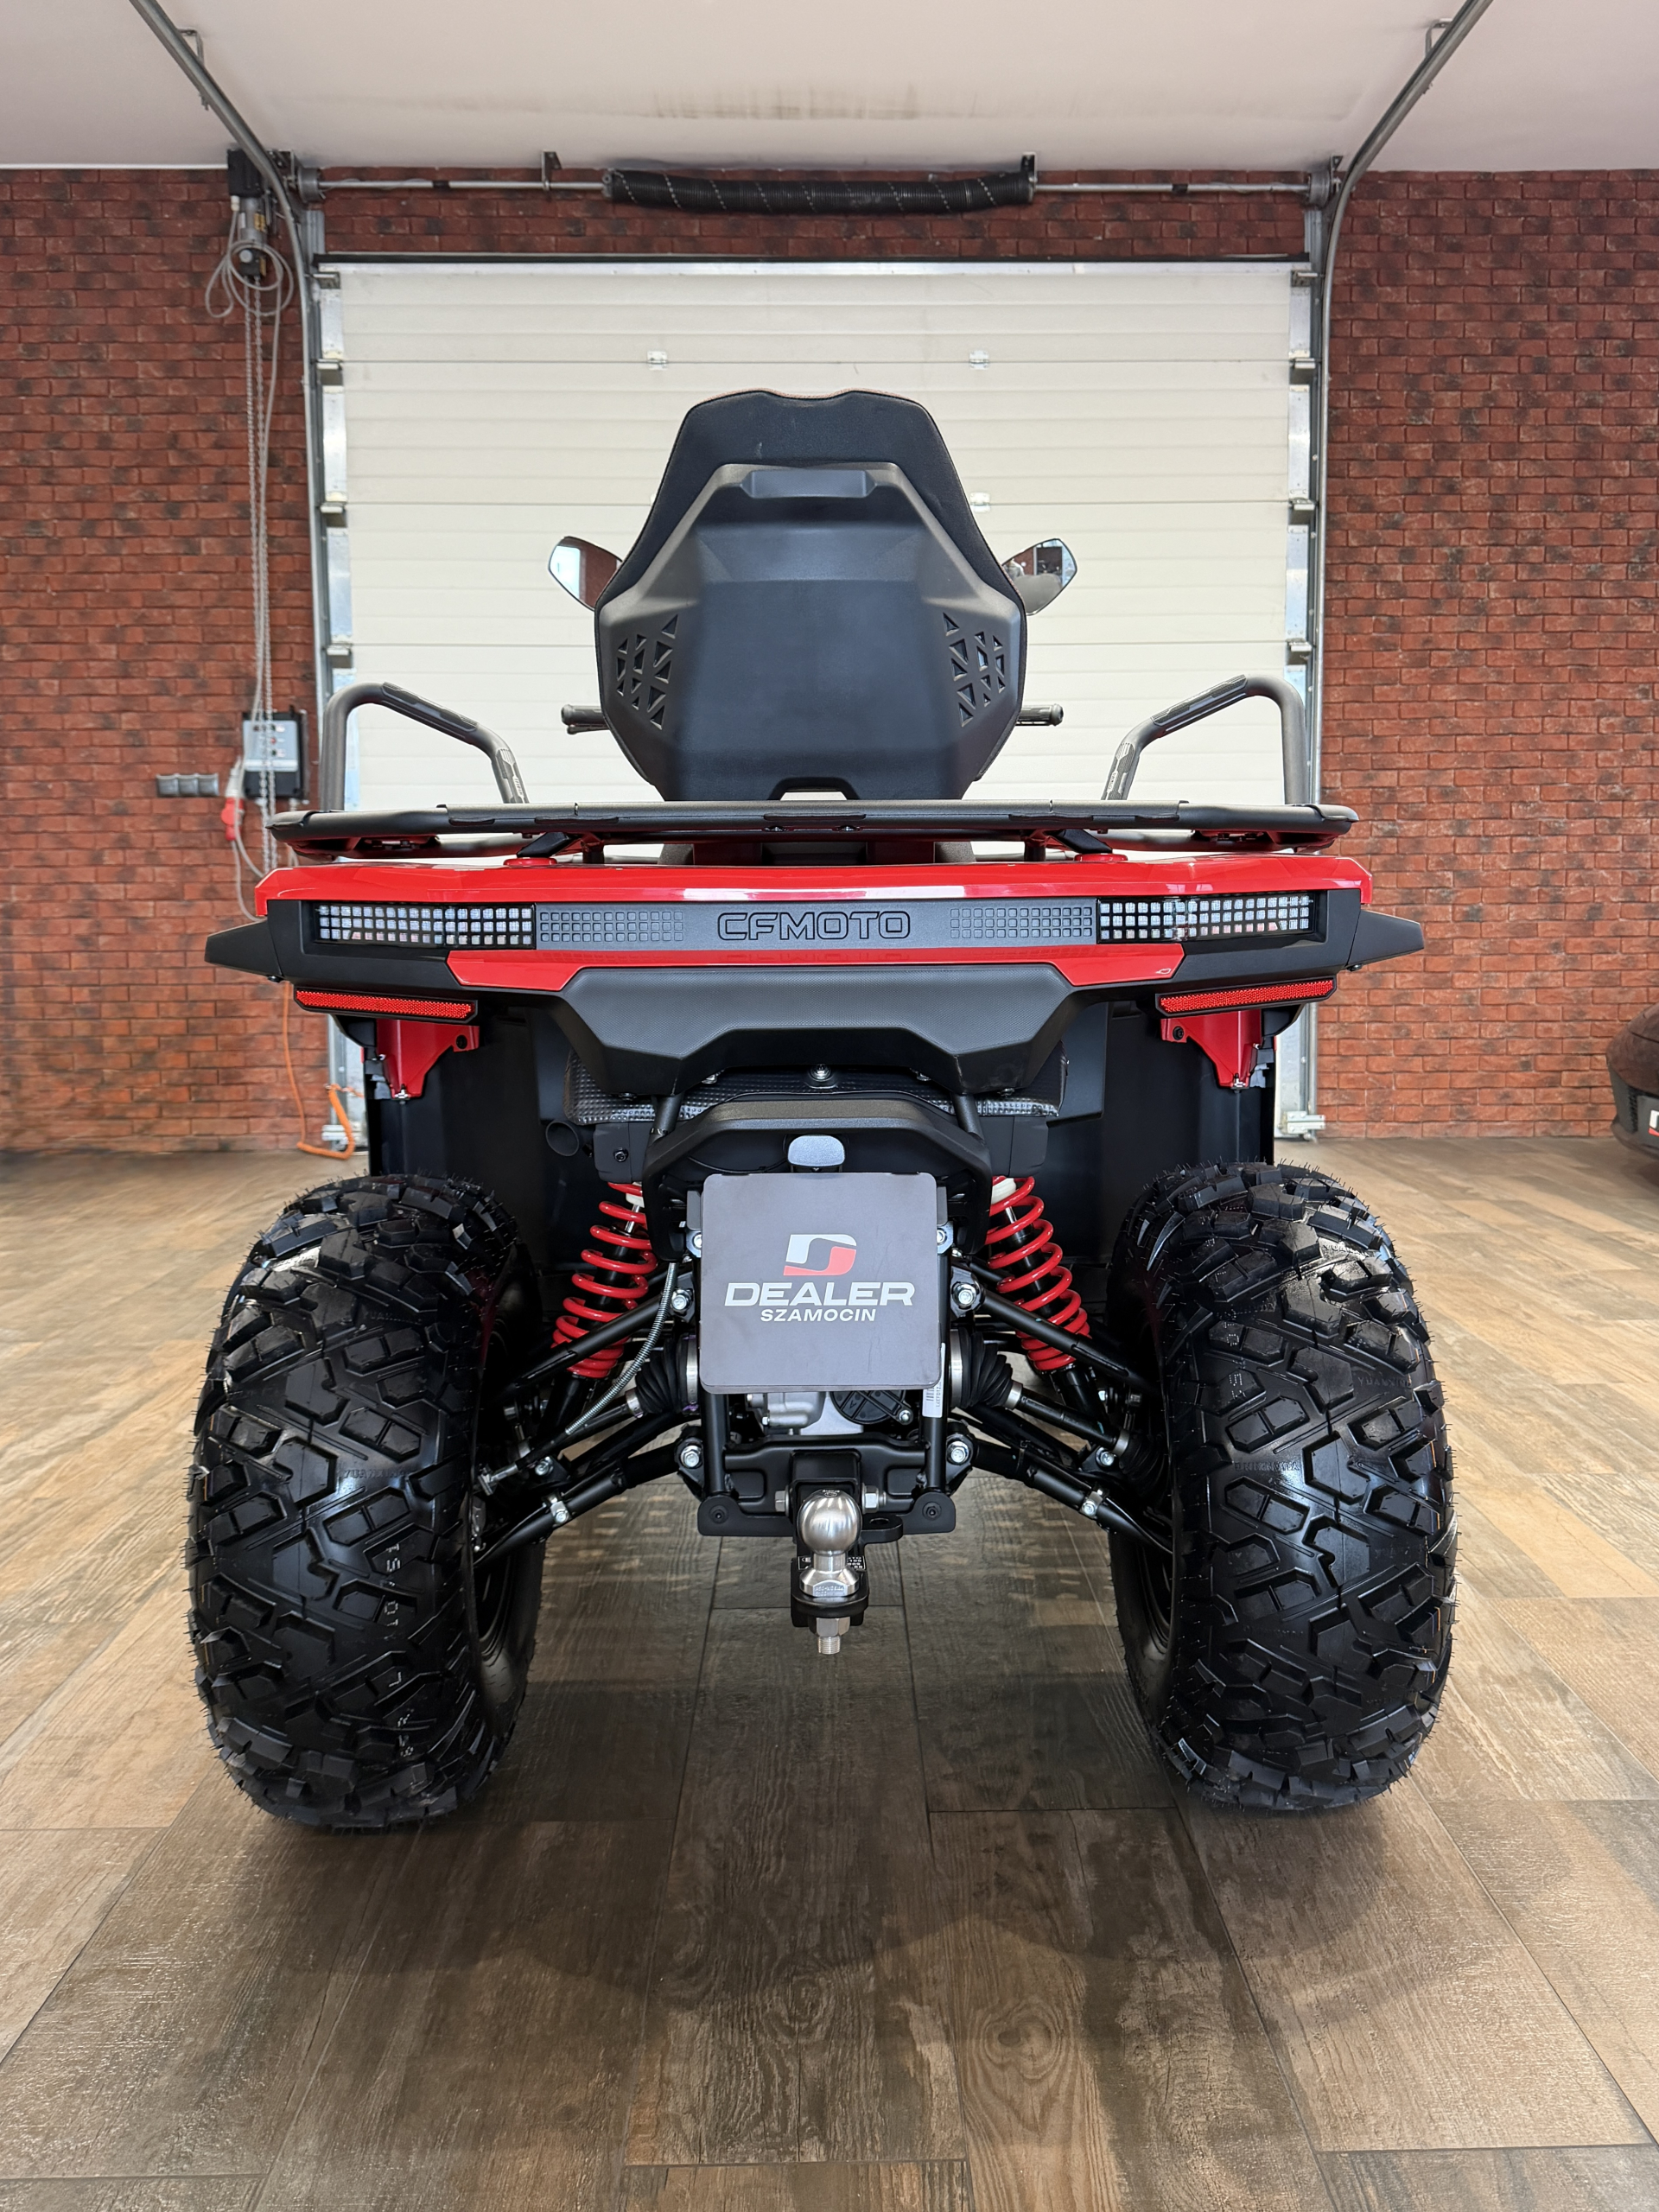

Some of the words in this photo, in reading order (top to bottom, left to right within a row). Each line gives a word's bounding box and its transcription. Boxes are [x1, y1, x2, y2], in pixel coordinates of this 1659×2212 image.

[717, 911, 911, 941] CFMOTO
[724, 1281, 915, 1306] DEALER
[760, 1308, 876, 1322] SZAMOCIN
